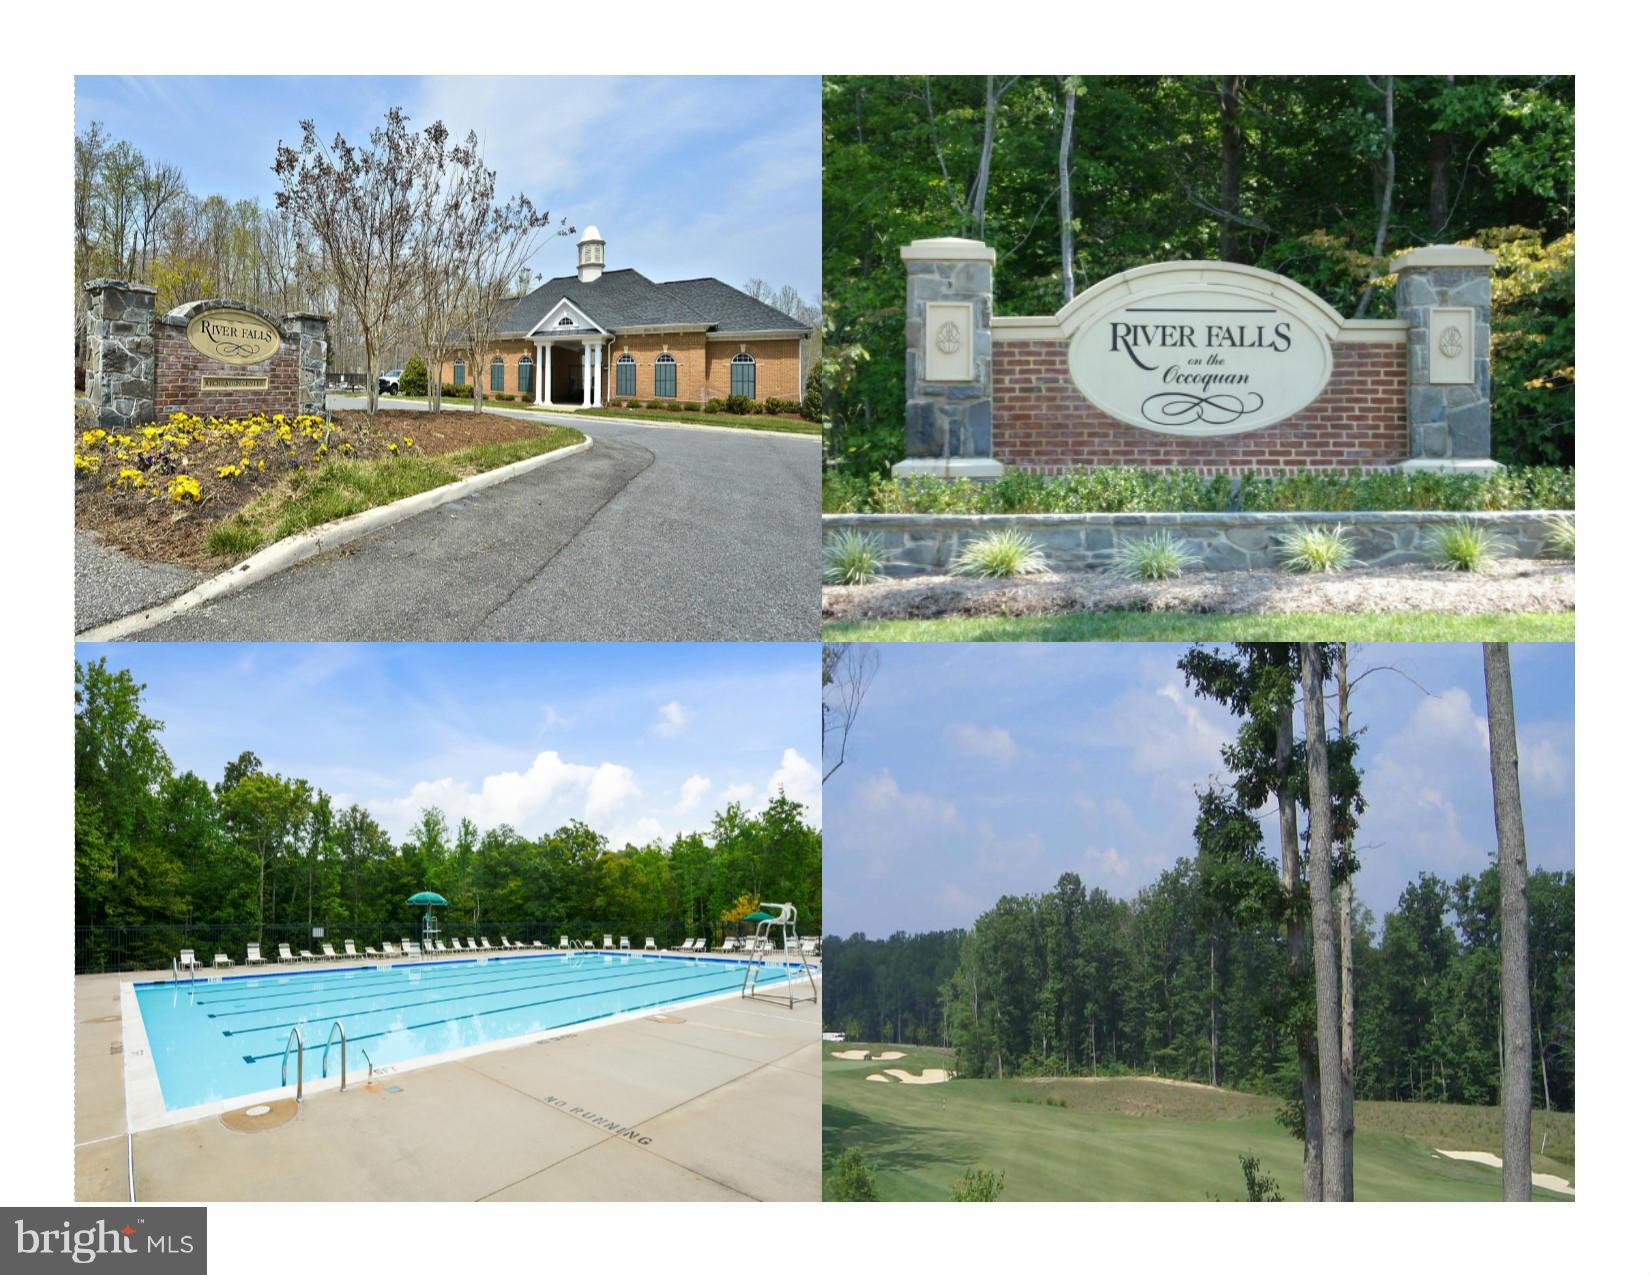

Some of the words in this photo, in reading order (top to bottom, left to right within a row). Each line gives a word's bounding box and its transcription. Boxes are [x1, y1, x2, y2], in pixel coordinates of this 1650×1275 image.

[201, 320, 237, 343] RIVER
[242, 328, 272, 343] FALLS
[1109, 322, 1198, 370] RIVER
[1206, 322, 1291, 352] FALLS
[1187, 357, 1202, 365] on
[1206, 353, 1226, 365] the
[1163, 364, 1249, 392] Occoquan
[545, 1095, 567, 1107] NO
[569, 1106, 652, 1146] RUNNING
